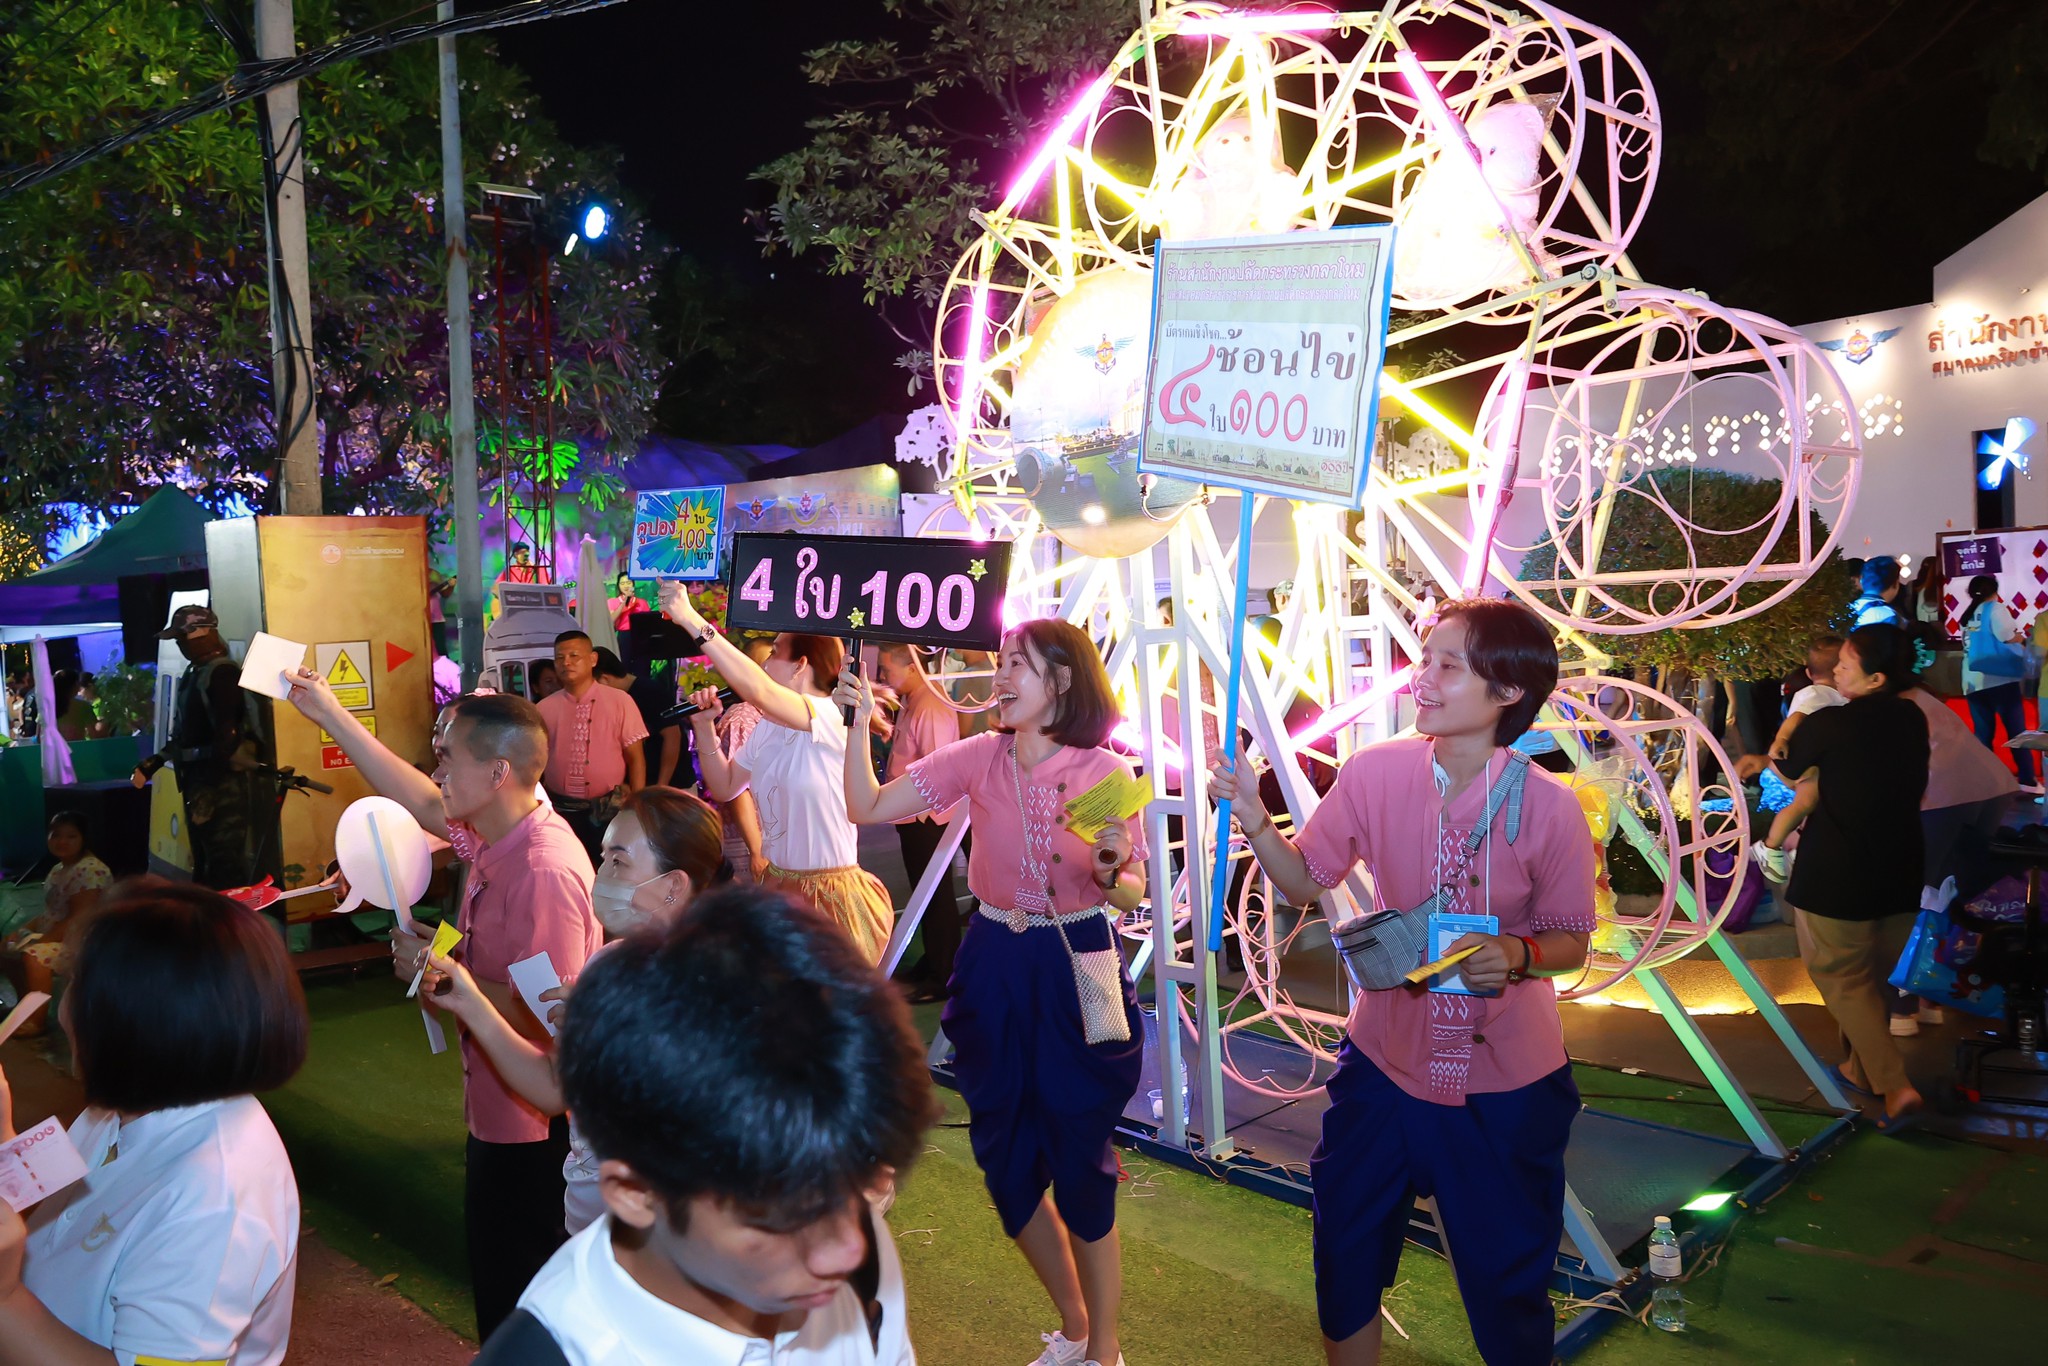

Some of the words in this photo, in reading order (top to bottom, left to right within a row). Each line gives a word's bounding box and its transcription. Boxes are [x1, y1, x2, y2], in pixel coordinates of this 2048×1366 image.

[1216, 328, 1356, 380] ช้อนไข่
[1158, 343, 1216, 428] ๔
[1209, 403, 1227, 433] ใบ
[1229, 389, 1308, 442] ๑๐๐
[1312, 426, 1346, 449] บาท
[676, 496, 690, 524] 4
[694, 513, 705, 524] ใบ
[637, 516, 676, 545] คูปอง
[676, 528, 707, 550] 100
[696, 551, 714, 561] บาท
[1980, 544, 1988, 553] 2
[740, 558, 775, 612] 4
[795, 546, 842, 620] ใบ
[860, 570, 976, 632] 100
